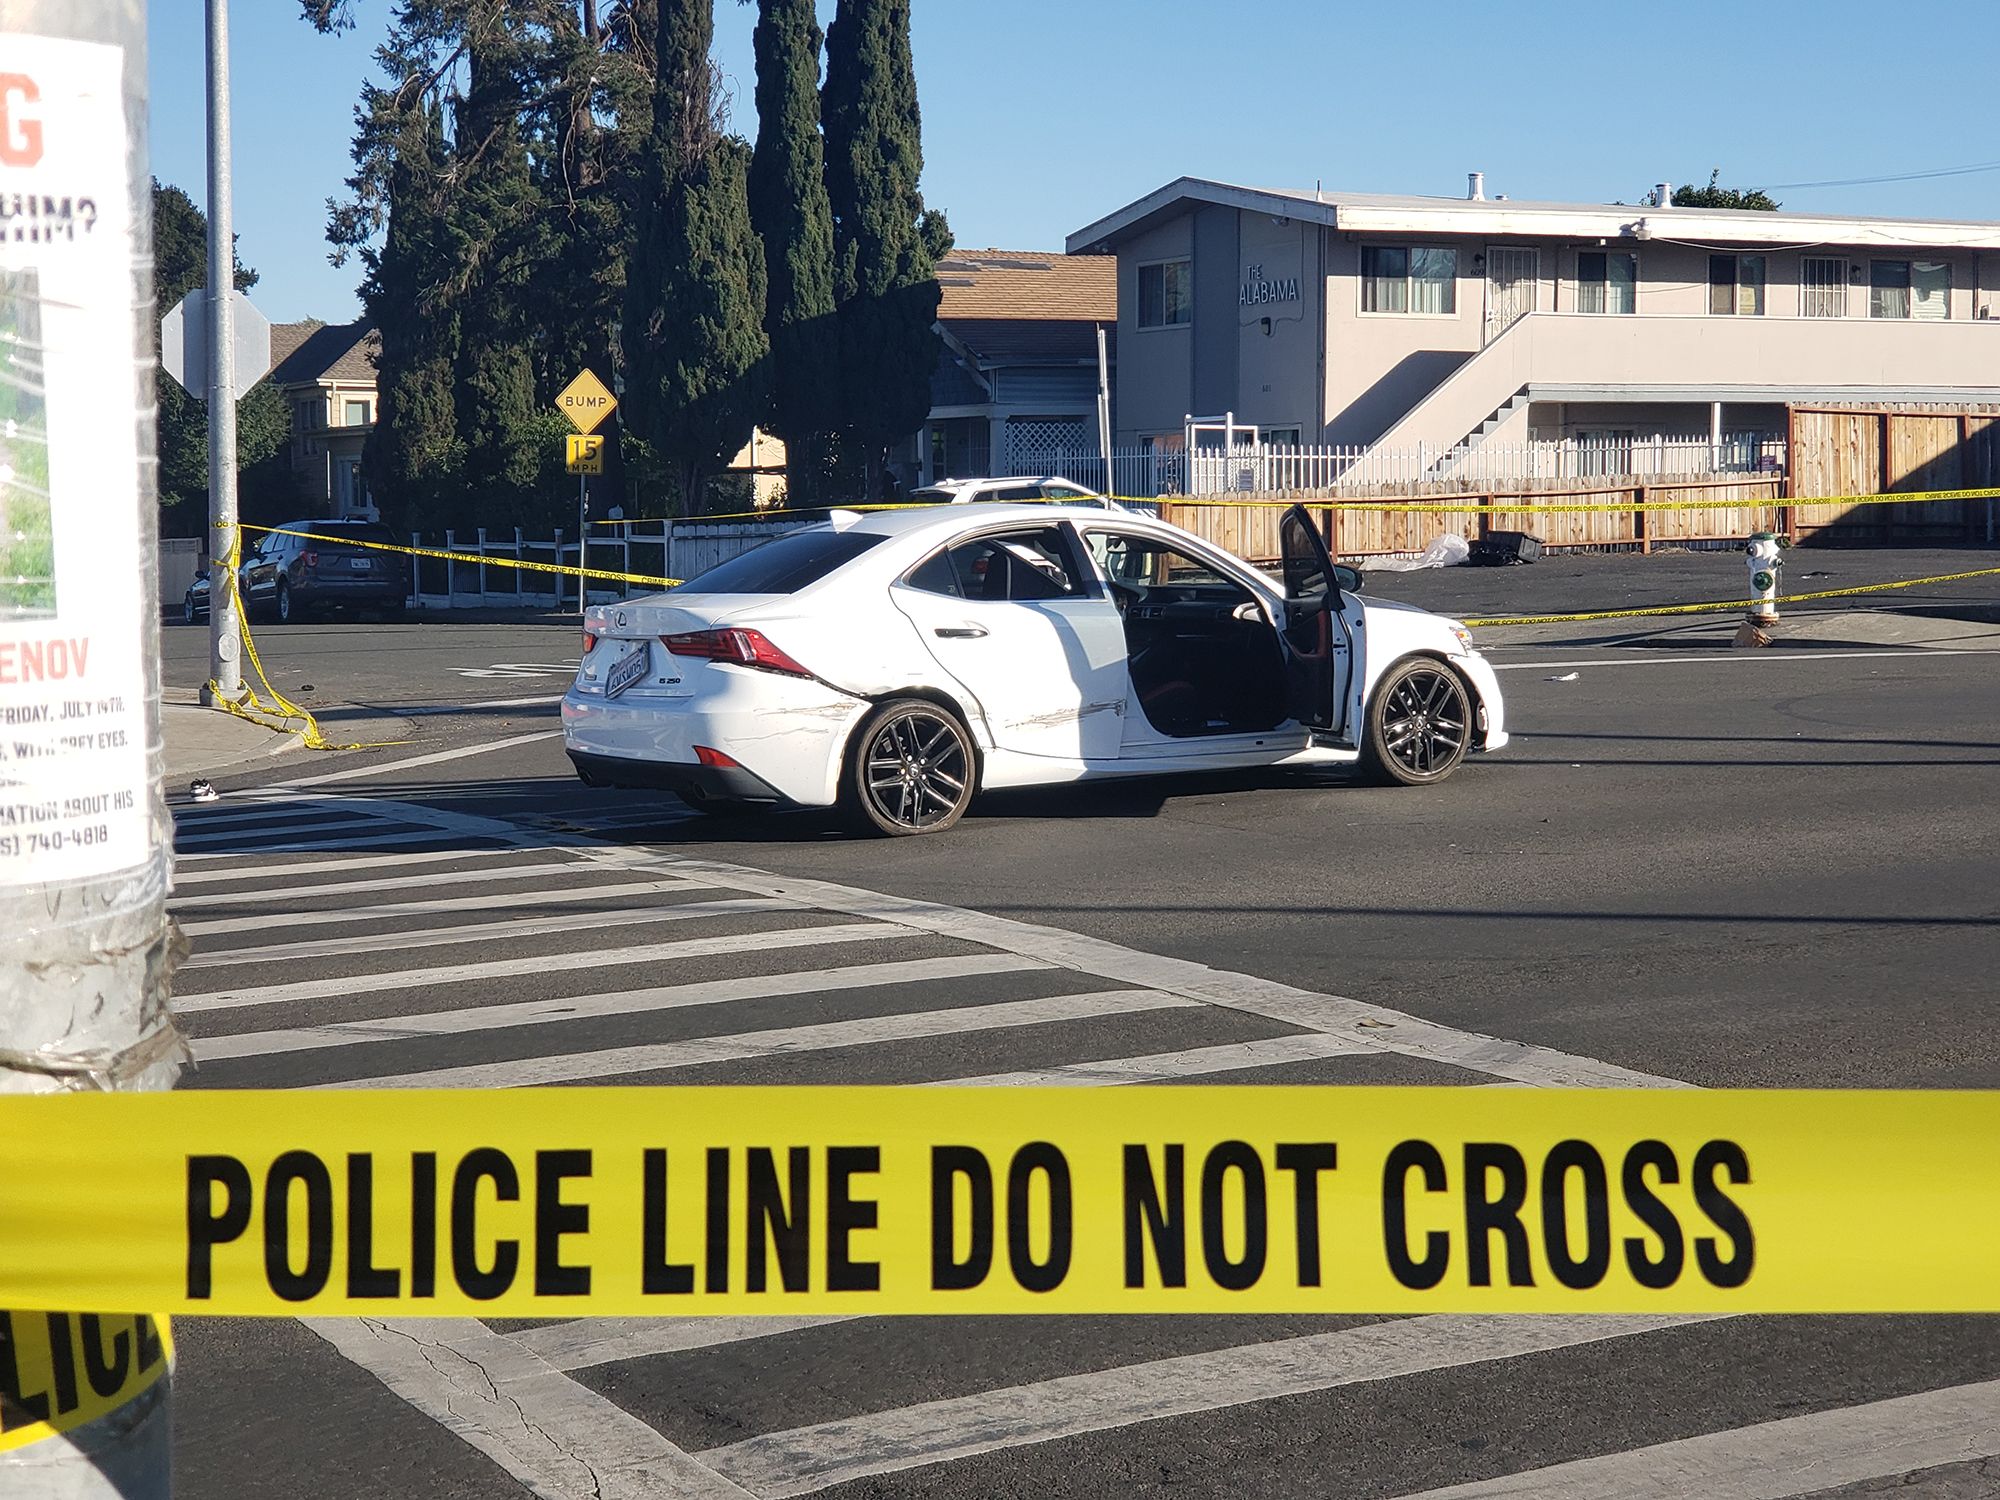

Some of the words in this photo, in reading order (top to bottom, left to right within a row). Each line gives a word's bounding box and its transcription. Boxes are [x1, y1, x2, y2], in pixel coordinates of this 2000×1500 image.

[1247, 264, 1263, 280] THE
[1239, 279, 1298, 305] ALABAMA
[565, 396, 607, 407] BUMP
[574, 440, 598, 461] 15
[571, 464, 598, 473] MPH
[60, 701, 92, 720] JULY
[98, 730, 128, 750] EYES.
[63, 794, 109, 820] ABOUT
[114, 790, 134, 810] HIS
[26, 825, 108, 854] 740-4818
[187, 1148, 592, 1301] POLICE
[643, 1146, 880, 1294] LINE
[932, 1142, 1072, 1292] DO
[1124, 1140, 1336, 1290] NOT
[1383, 1140, 1754, 1290] CROSS
